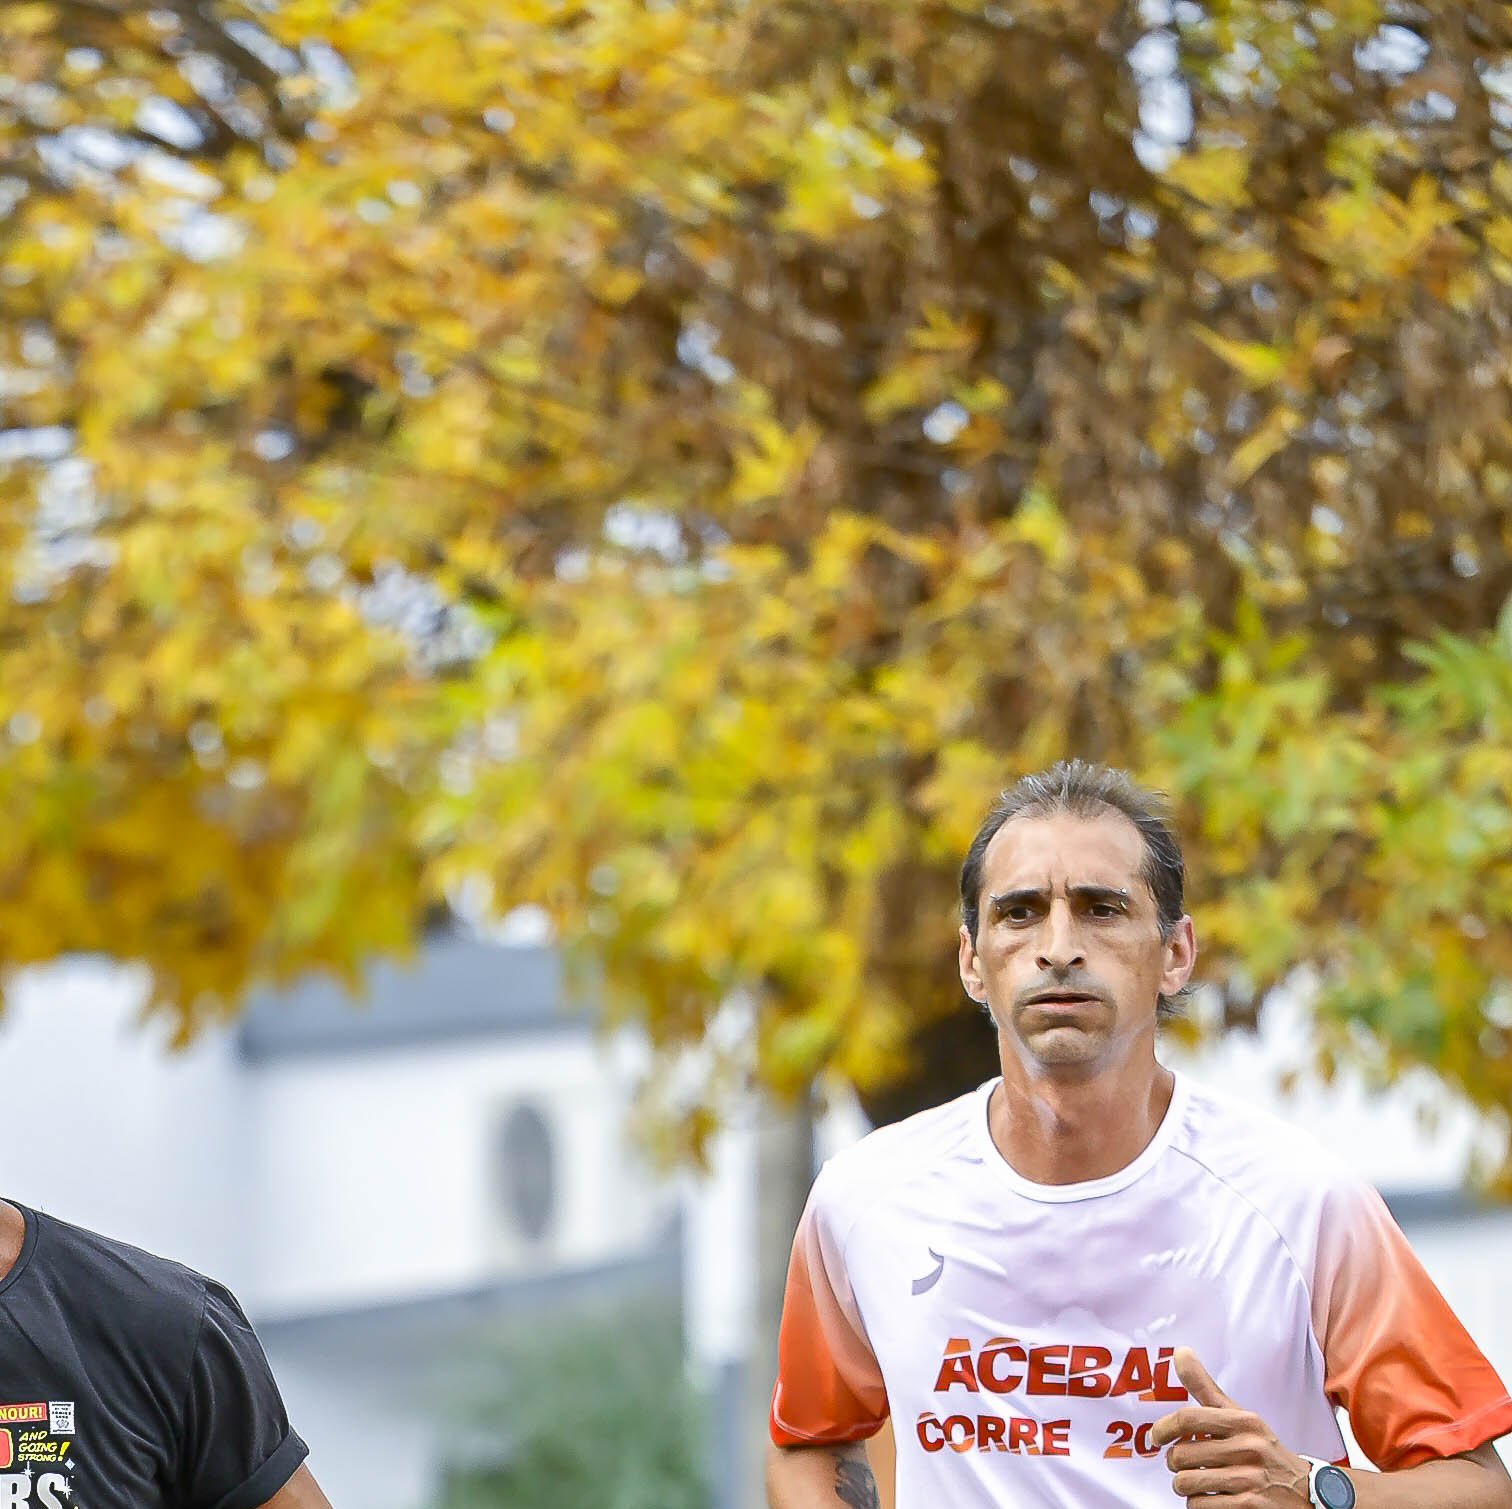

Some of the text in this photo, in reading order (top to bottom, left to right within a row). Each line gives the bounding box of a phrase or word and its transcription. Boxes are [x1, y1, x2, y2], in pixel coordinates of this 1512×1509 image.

[933, 1337, 1188, 1402] ACEBAL
[18, 1442, 58, 1452] GOING
[19, 1430, 48, 1441] AND
[916, 1411, 1071, 1457] CORRE
